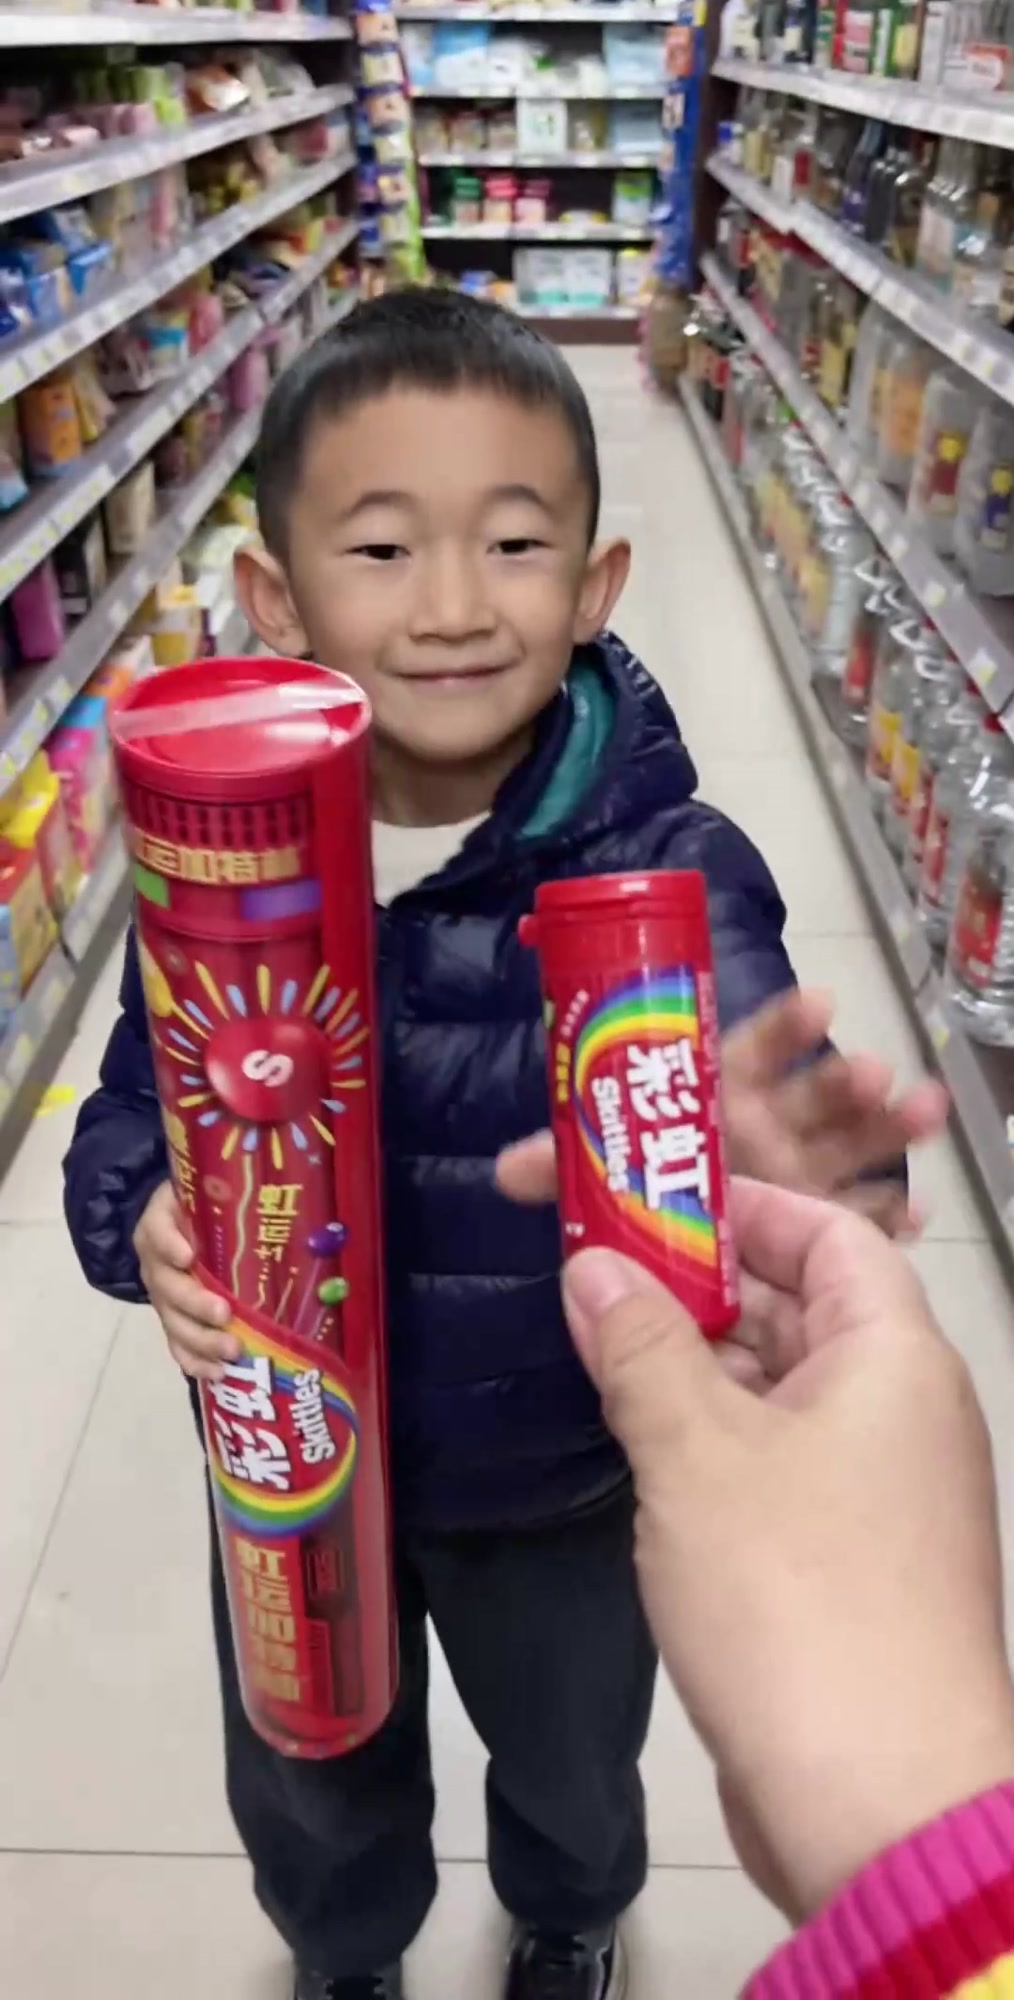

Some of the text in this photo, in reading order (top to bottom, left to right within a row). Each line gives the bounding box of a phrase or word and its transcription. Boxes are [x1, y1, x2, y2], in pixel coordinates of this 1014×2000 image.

[241, 1048, 295, 1088] S
[626, 1036, 711, 1212] 彩虹
[590, 1076, 632, 1194] Skittles
[209, 1355, 293, 1492] 彩虹
[290, 1367, 336, 1466] Skittles
